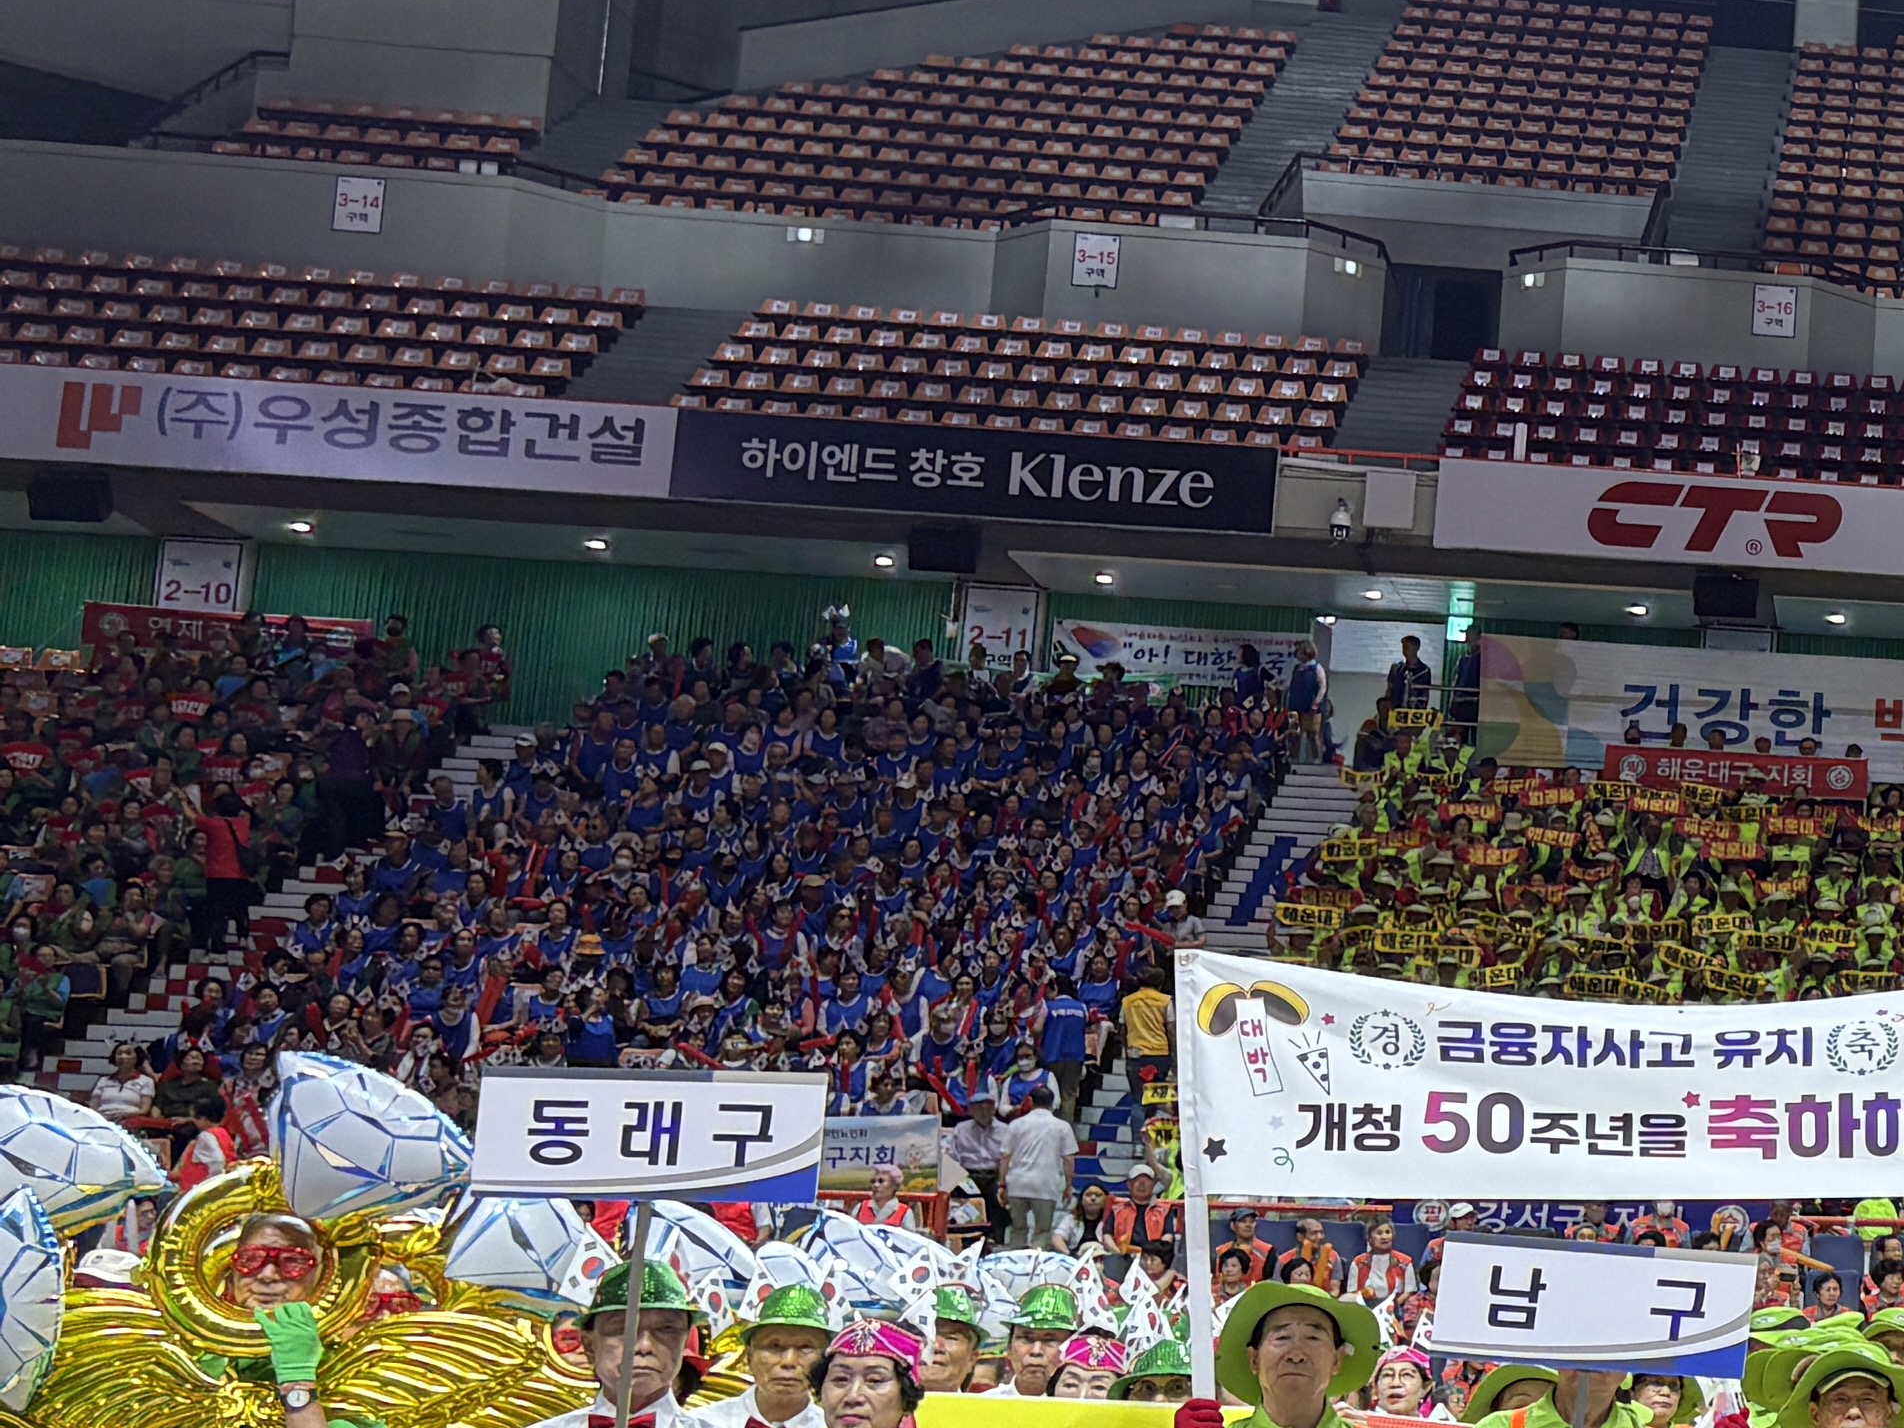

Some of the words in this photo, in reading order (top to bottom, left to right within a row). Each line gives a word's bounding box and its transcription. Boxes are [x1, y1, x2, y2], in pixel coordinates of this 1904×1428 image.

[338, 192, 380, 209] 3-14
[1078, 249, 1116, 265] 3-15
[1757, 300, 1792, 315] 3-16
[156, 384, 647, 466] (주)우성종합건설
[741, 438, 899, 483] 하이엔드
[909, 450, 986, 489] 창호
[1008, 451, 1214, 509] Klenze
[1587, 481, 1843, 558] CTR
[164, 580, 231, 604] 2-10
[968, 625, 1028, 647] 2-11
[1621, 683, 1831, 750] 건강한
[1373, 1022, 1401, 1056] 경
[1437, 1020, 1695, 1069] 금융자사고
[1713, 1026, 1813, 1070] 유치
[1844, 1025, 1881, 1061] 축
[1295, 1103, 1402, 1152] 개청
[1421, 1091, 1688, 1159] 50주년을
